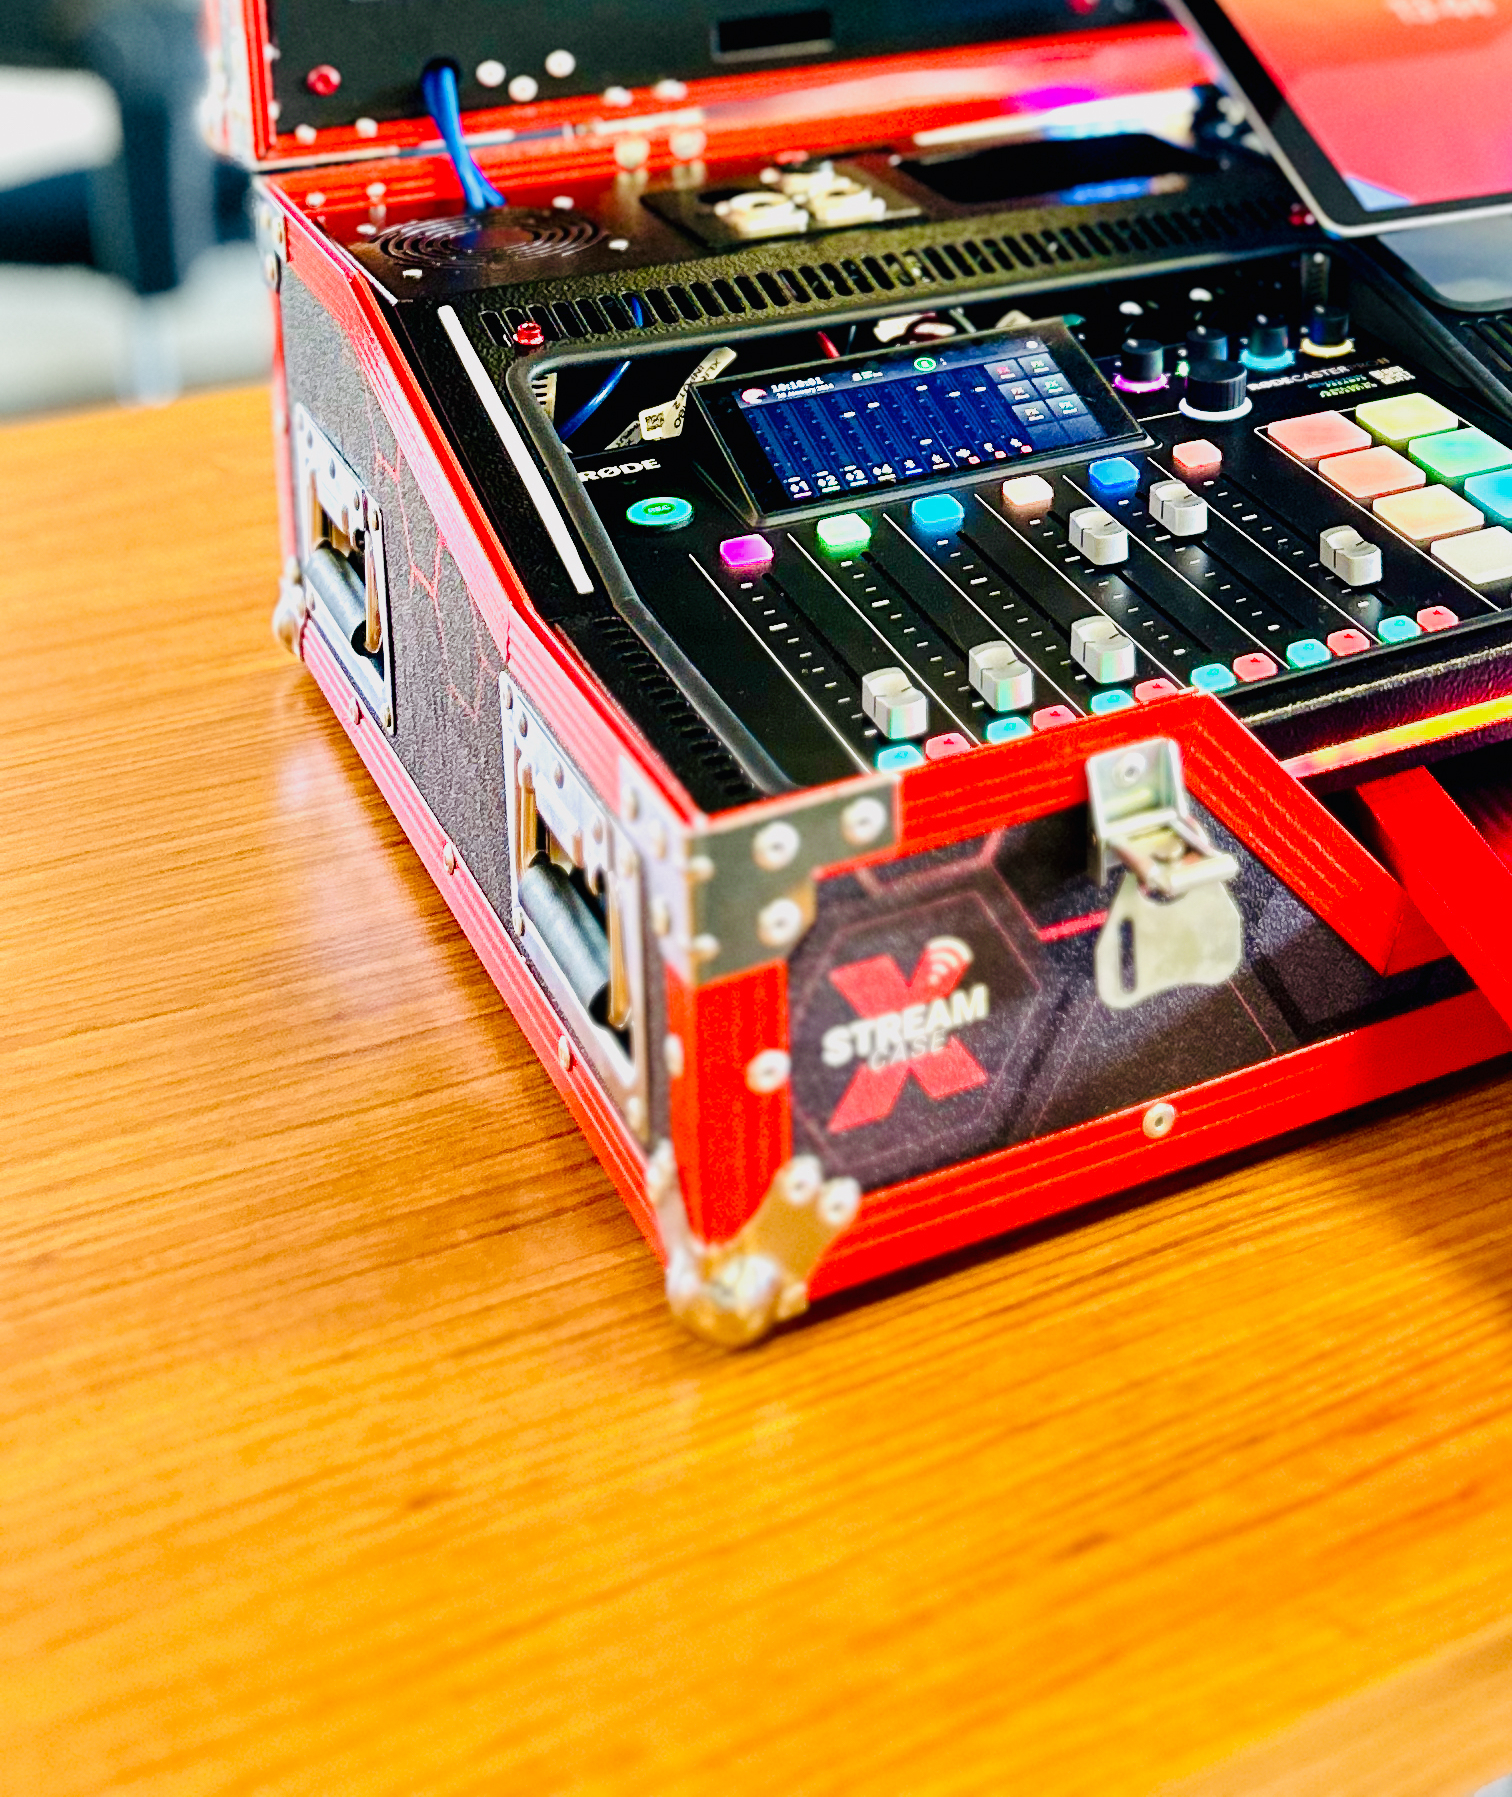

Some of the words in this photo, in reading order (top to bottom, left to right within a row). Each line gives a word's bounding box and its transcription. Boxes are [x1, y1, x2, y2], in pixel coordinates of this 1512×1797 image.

[577, 458, 662, 483] RØDE
[821, 983, 990, 1071] STREAM
[867, 1027, 948, 1075] CASE
